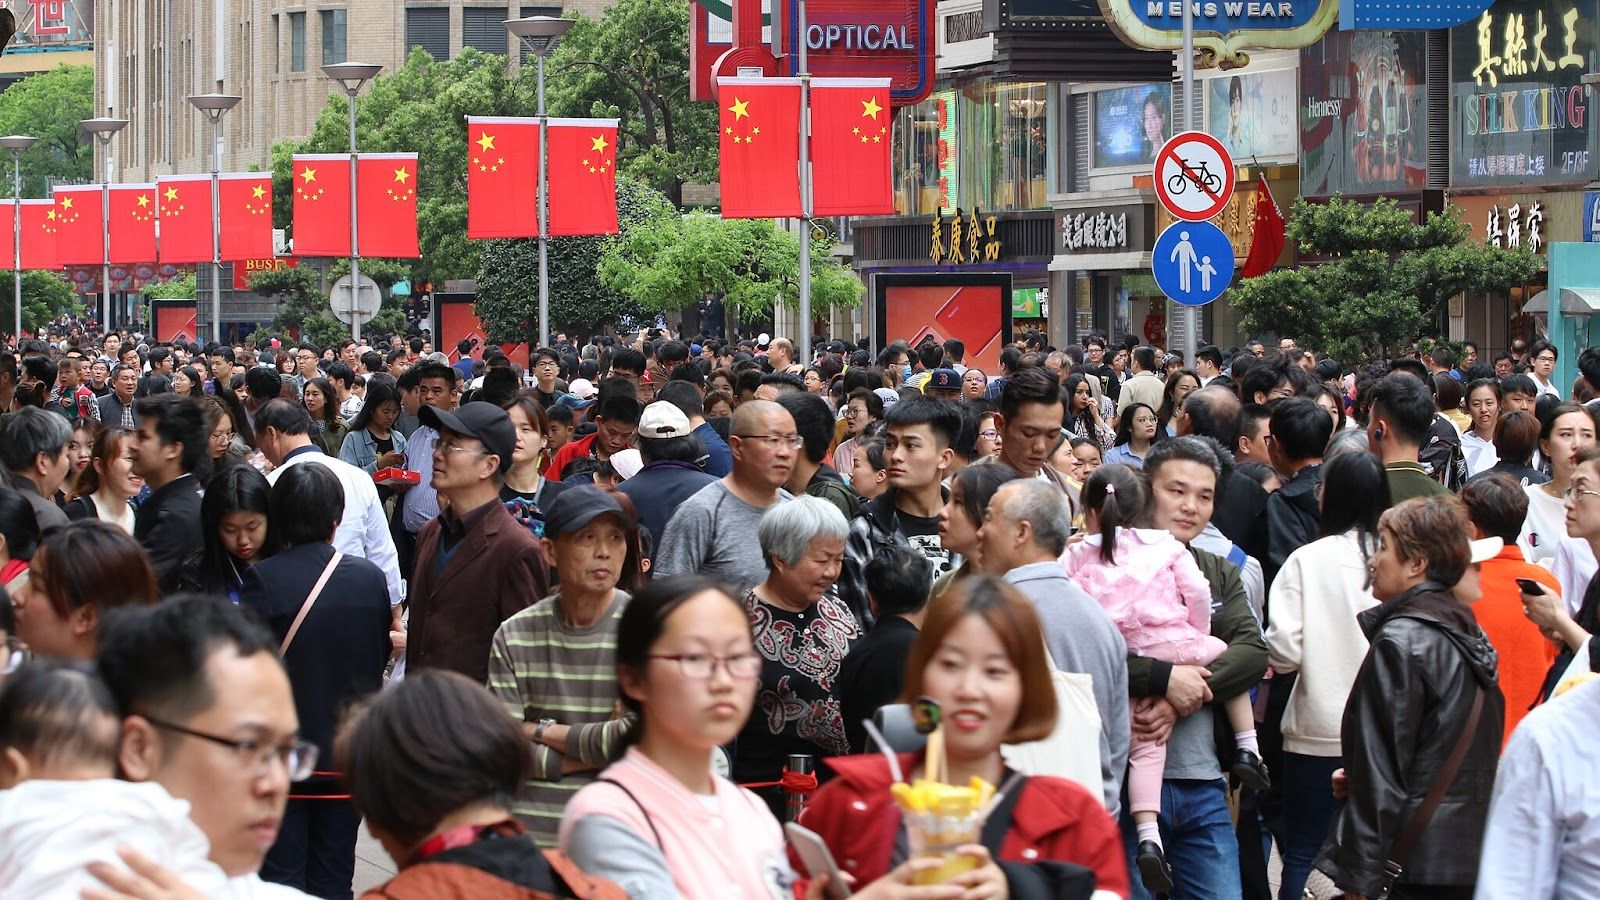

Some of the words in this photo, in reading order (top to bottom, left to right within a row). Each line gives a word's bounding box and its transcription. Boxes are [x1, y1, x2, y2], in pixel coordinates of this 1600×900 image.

[1224, 2, 1294, 17] WEAR
[806, 24, 914, 50] OPTICAL
[1308, 96, 1342, 119] Hennessy
[1466, 91, 1519, 135] SILK
[1523, 85, 1586, 131] KING
[929, 206, 1000, 265] 泰康食品
